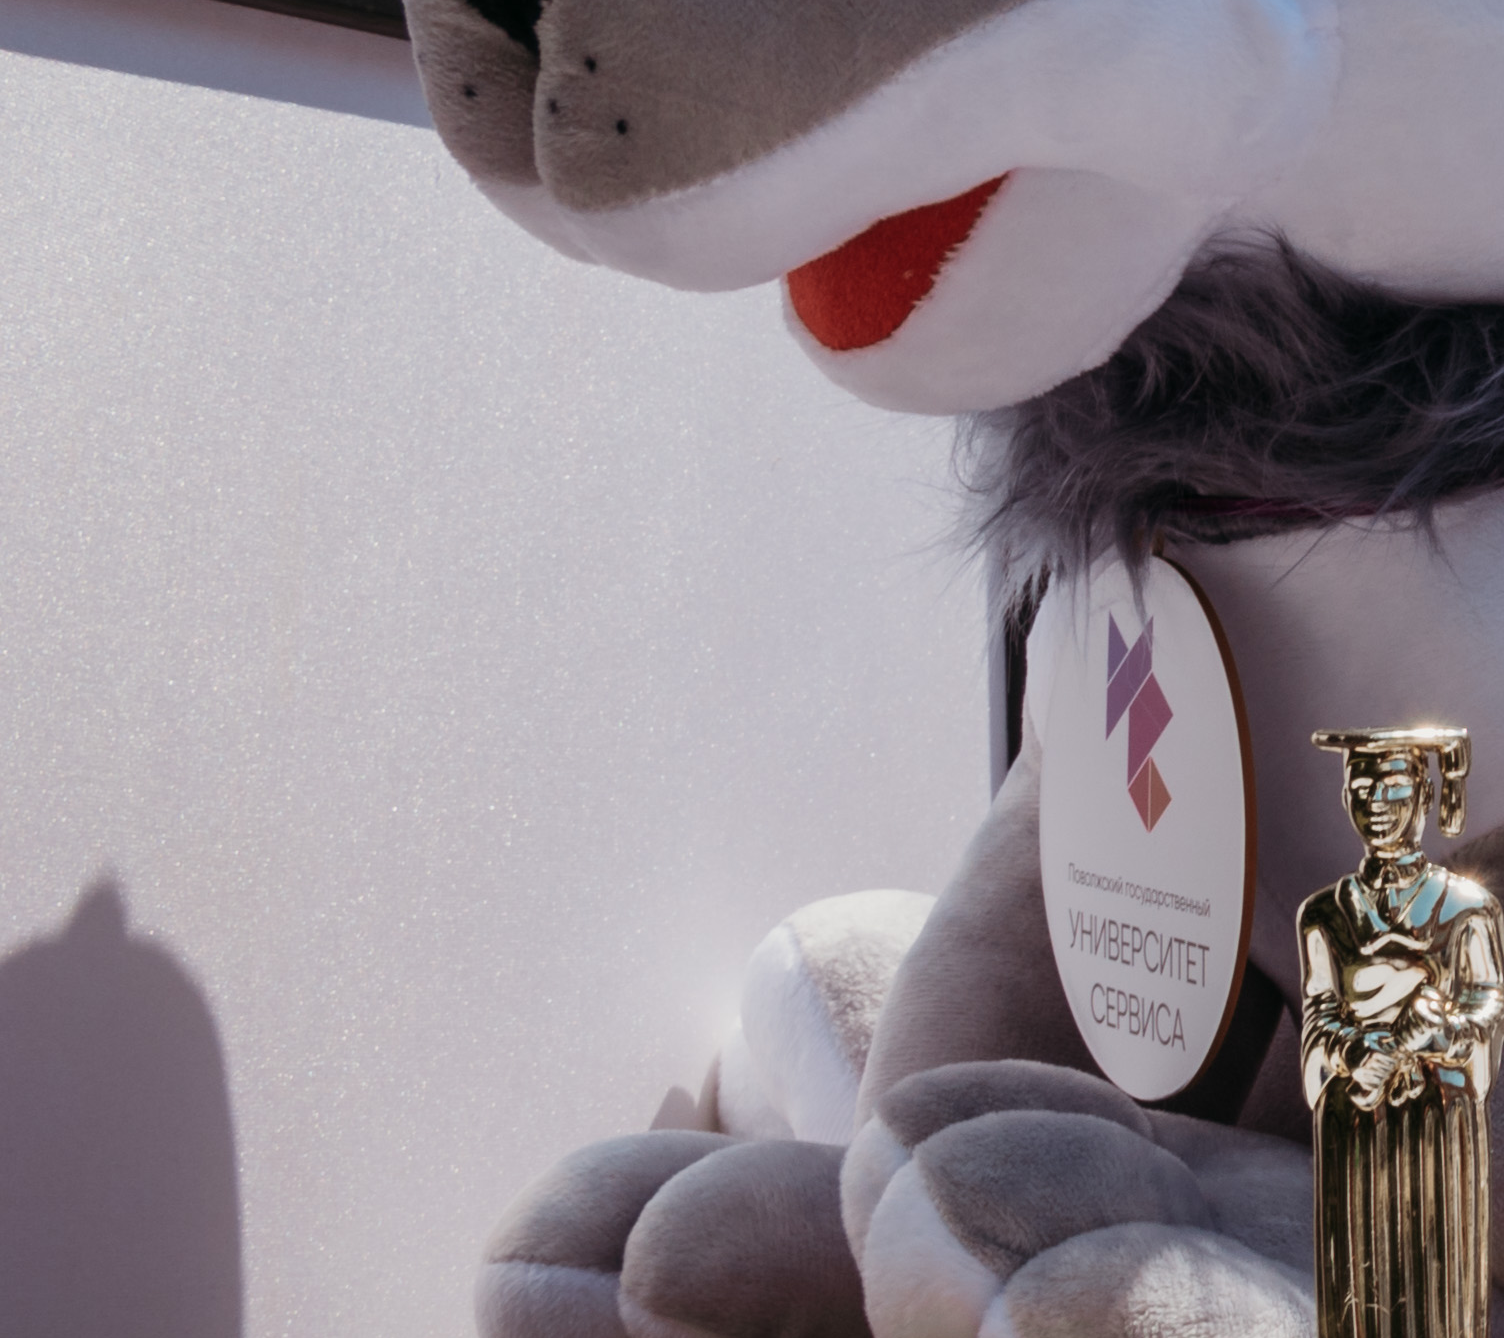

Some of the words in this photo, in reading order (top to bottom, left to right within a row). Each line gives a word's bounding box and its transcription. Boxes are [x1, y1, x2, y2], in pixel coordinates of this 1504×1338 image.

[1068, 863, 1125, 898] Поволжский
[1125, 877, 1211, 918] государственный
[1069, 909, 1210, 988] УНИВЕРСИТЕТ
[1090, 983, 1186, 1052] СЕРВИСА
